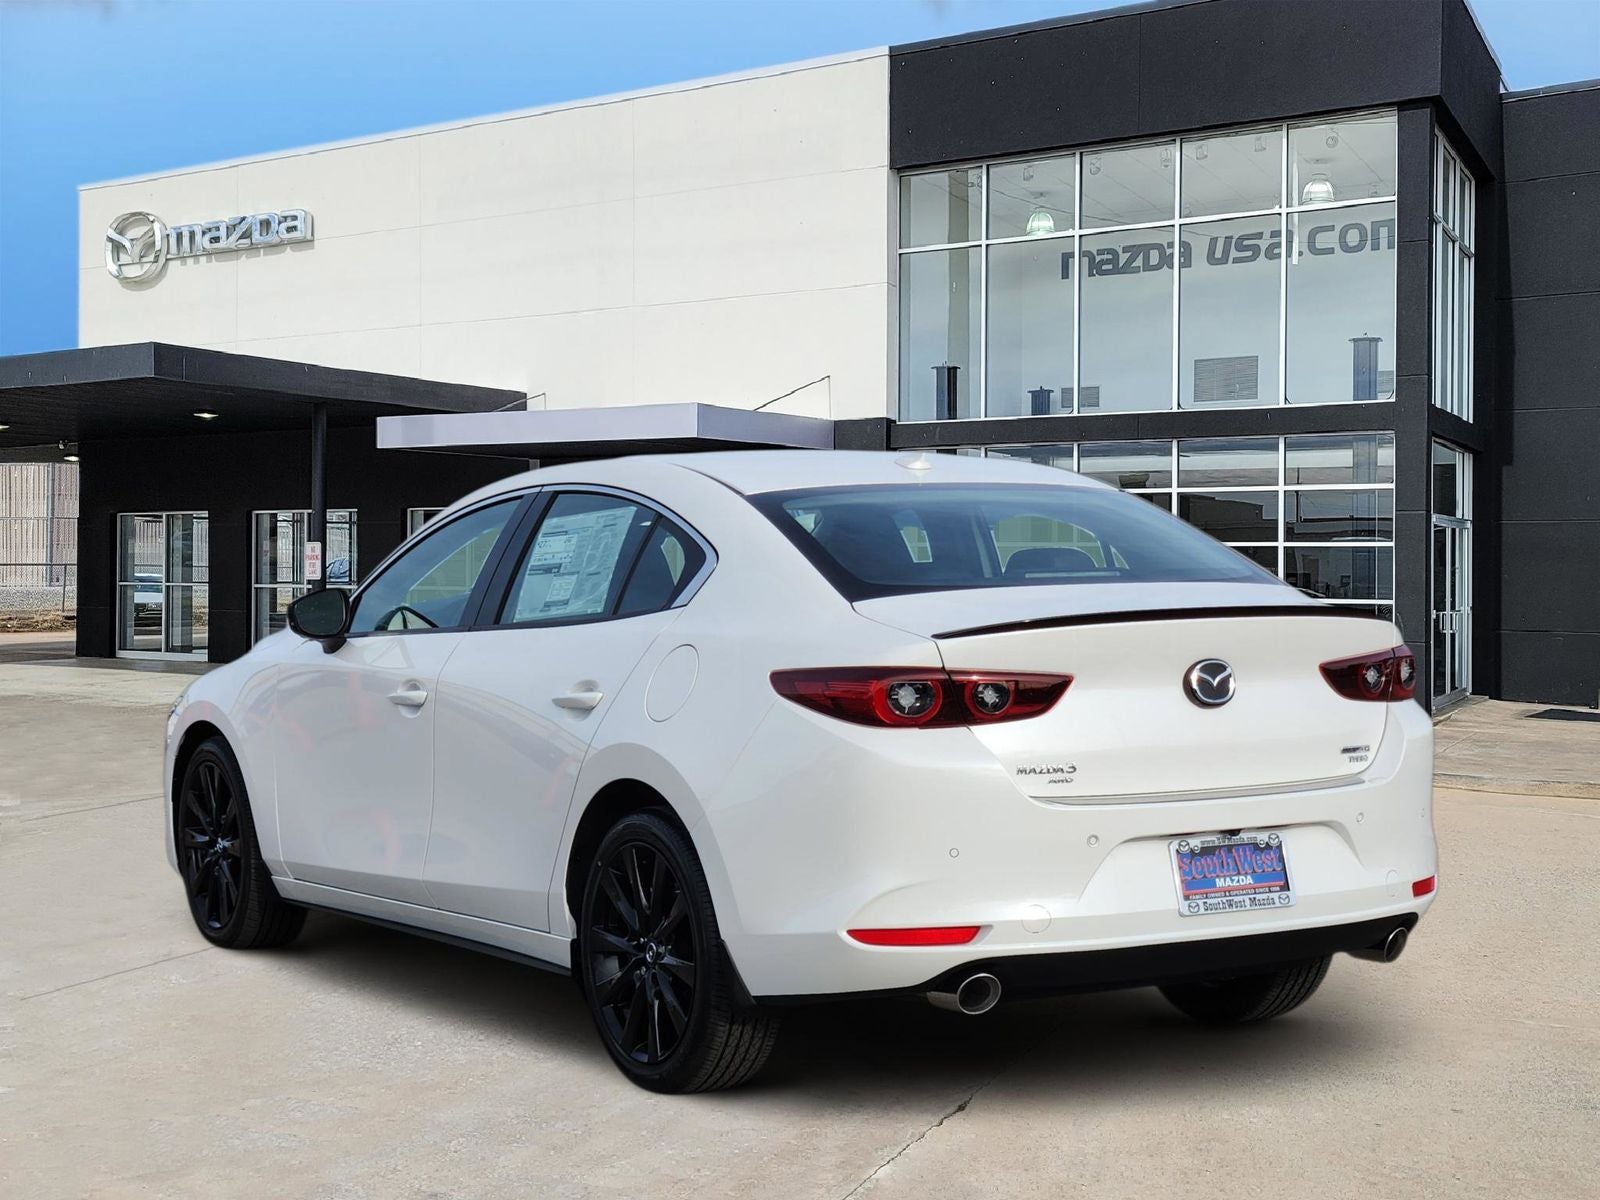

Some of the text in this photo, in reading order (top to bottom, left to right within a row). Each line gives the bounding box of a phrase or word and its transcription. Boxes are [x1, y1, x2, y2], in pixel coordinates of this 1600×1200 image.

[166, 209, 309, 256] mazda
[1061, 240, 1193, 280] mazda
[1178, 846, 1283, 880] SouthWest
[1215, 874, 1254, 888] MAZDA
[1203, 895, 1276, 912] SouthWest Mazda
